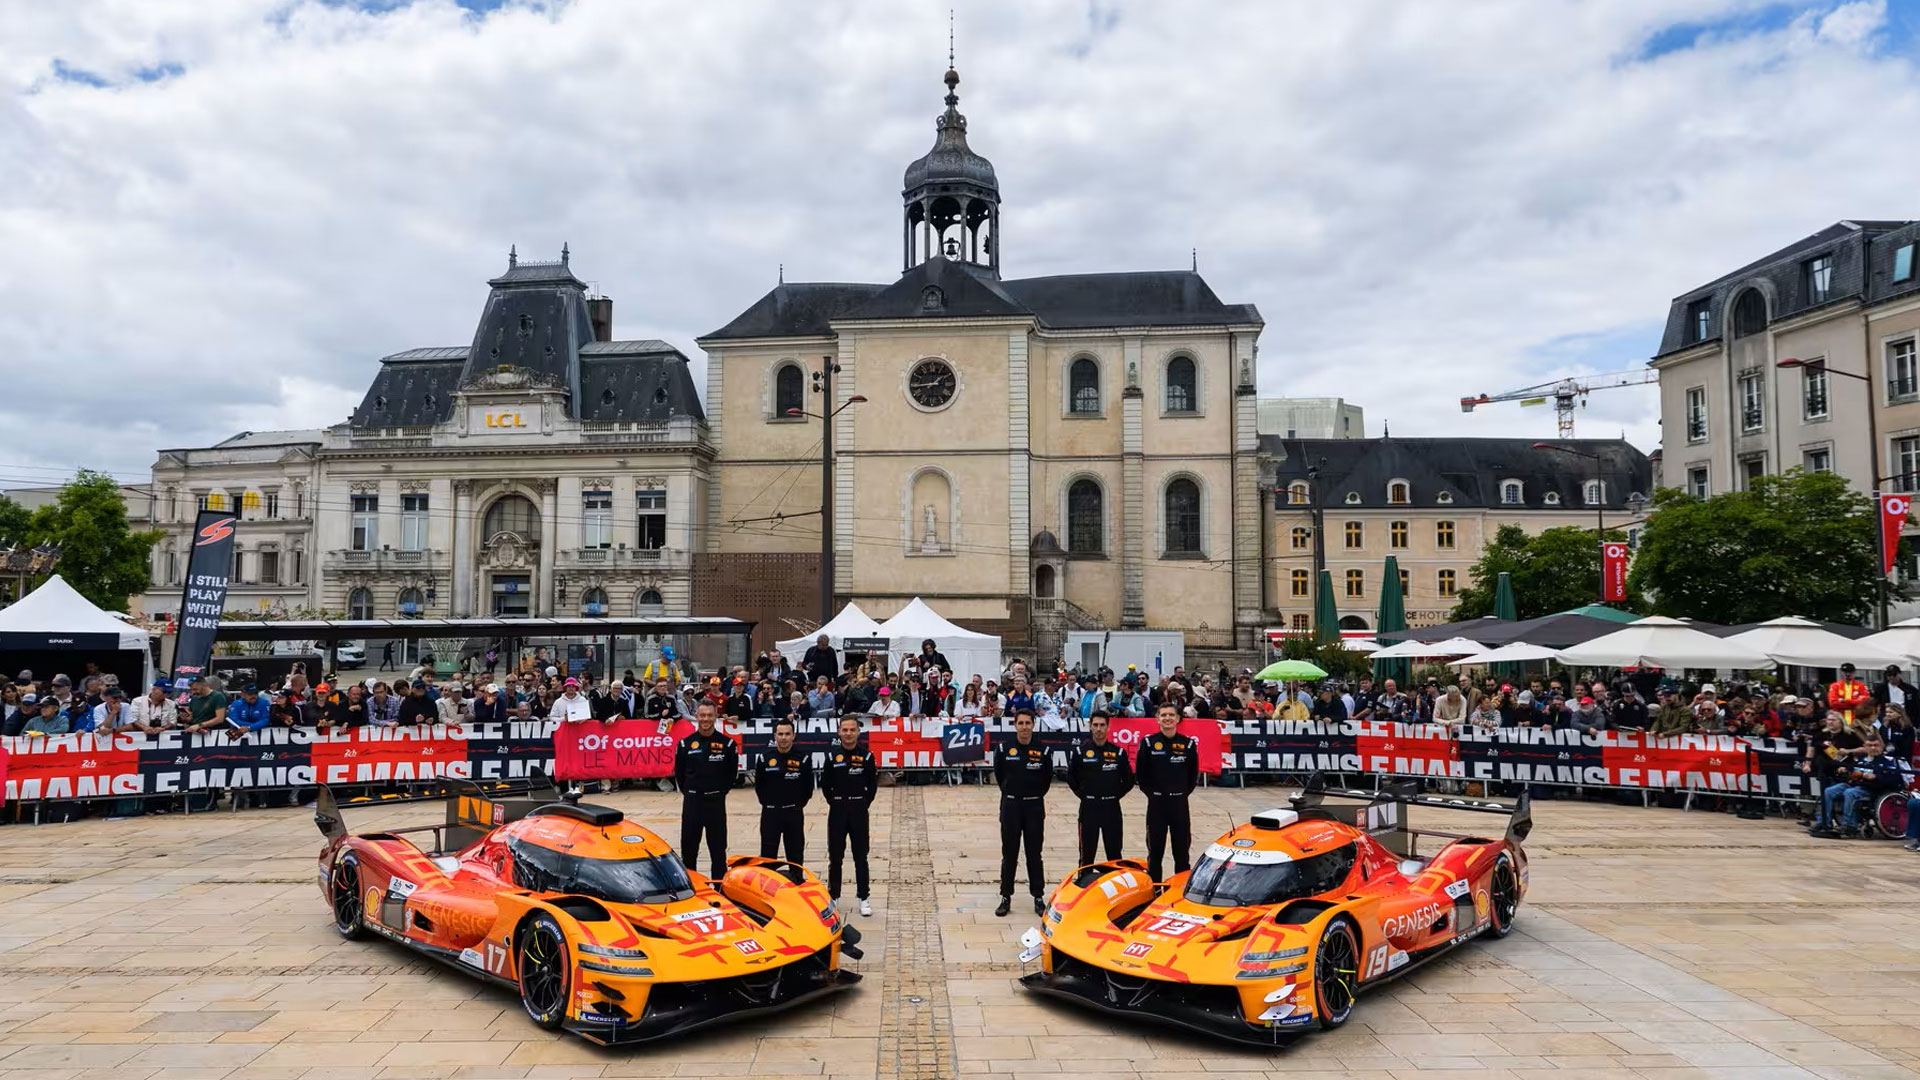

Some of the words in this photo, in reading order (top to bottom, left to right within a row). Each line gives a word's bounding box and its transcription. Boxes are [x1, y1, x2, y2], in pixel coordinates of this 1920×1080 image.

[486, 413, 527, 427] LCL
[189, 575, 193, 584] I
[196, 575, 228, 587] STILL
[190, 588, 222, 601] PLAY
[187, 602, 221, 615] WITH
[185, 617, 219, 629] CARS
[613, 735, 674, 749] course
[583, 750, 607, 769] LE
[617, 748, 674, 767] MANS
[692, 915, 724, 933] 17
[1146, 918, 1196, 935] 19
[1383, 902, 1442, 940] GENESIS
[737, 940, 759, 953] HY
[1126, 945, 1151, 957] HY
[487, 944, 507, 974] 17
[1365, 945, 1388, 978] 19
